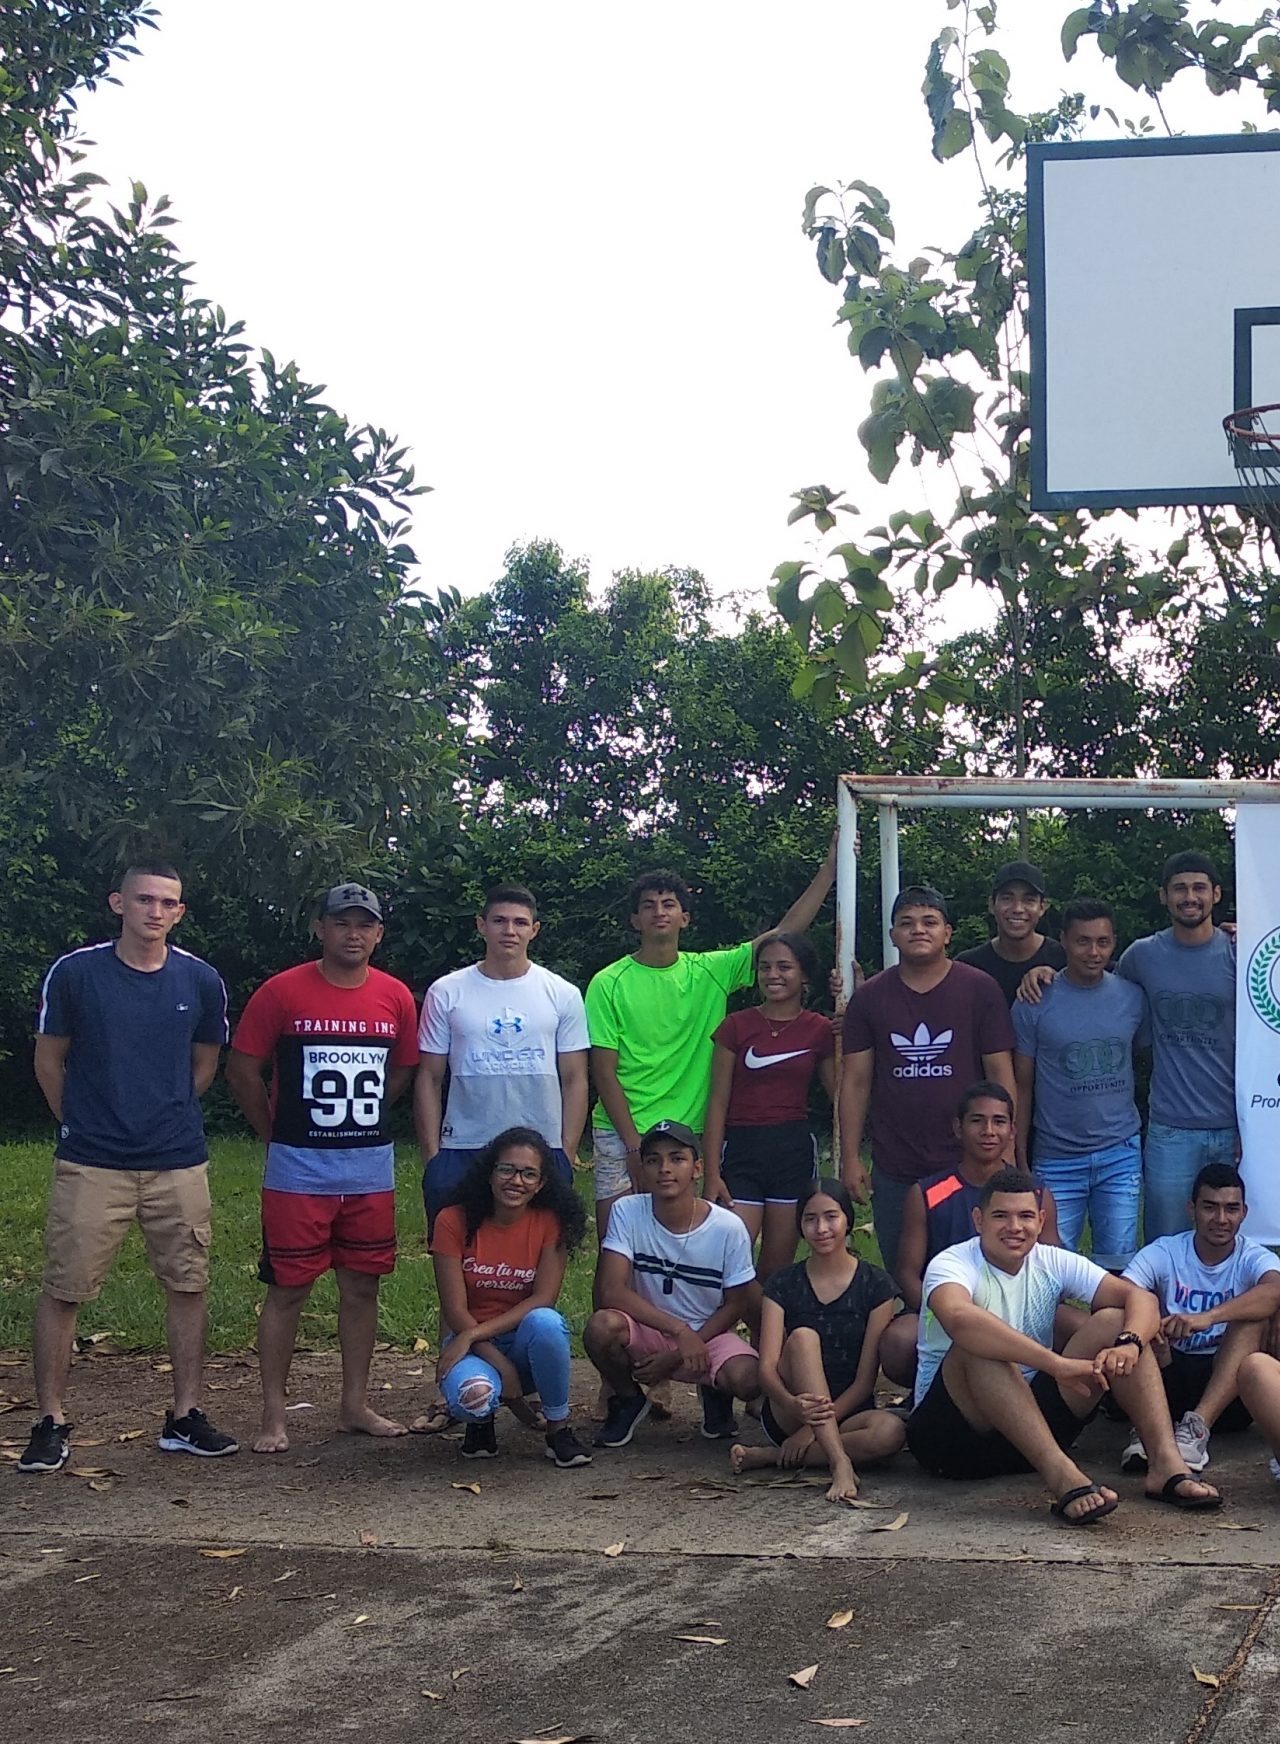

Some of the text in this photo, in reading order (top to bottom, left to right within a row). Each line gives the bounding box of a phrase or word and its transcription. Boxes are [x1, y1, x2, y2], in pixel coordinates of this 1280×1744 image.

[294, 1019, 367, 1033] TRAINING
[309, 1052, 385, 1064] BROOKLYN
[893, 1063, 953, 1078] adidas
[1070, 1080, 1126, 1094] OPPORTUNITY
[310, 1069, 380, 1127] 96
[308, 1130, 366, 1138] ESTABLISHMENT
[462, 1257, 536, 1283] Crea tu mej
